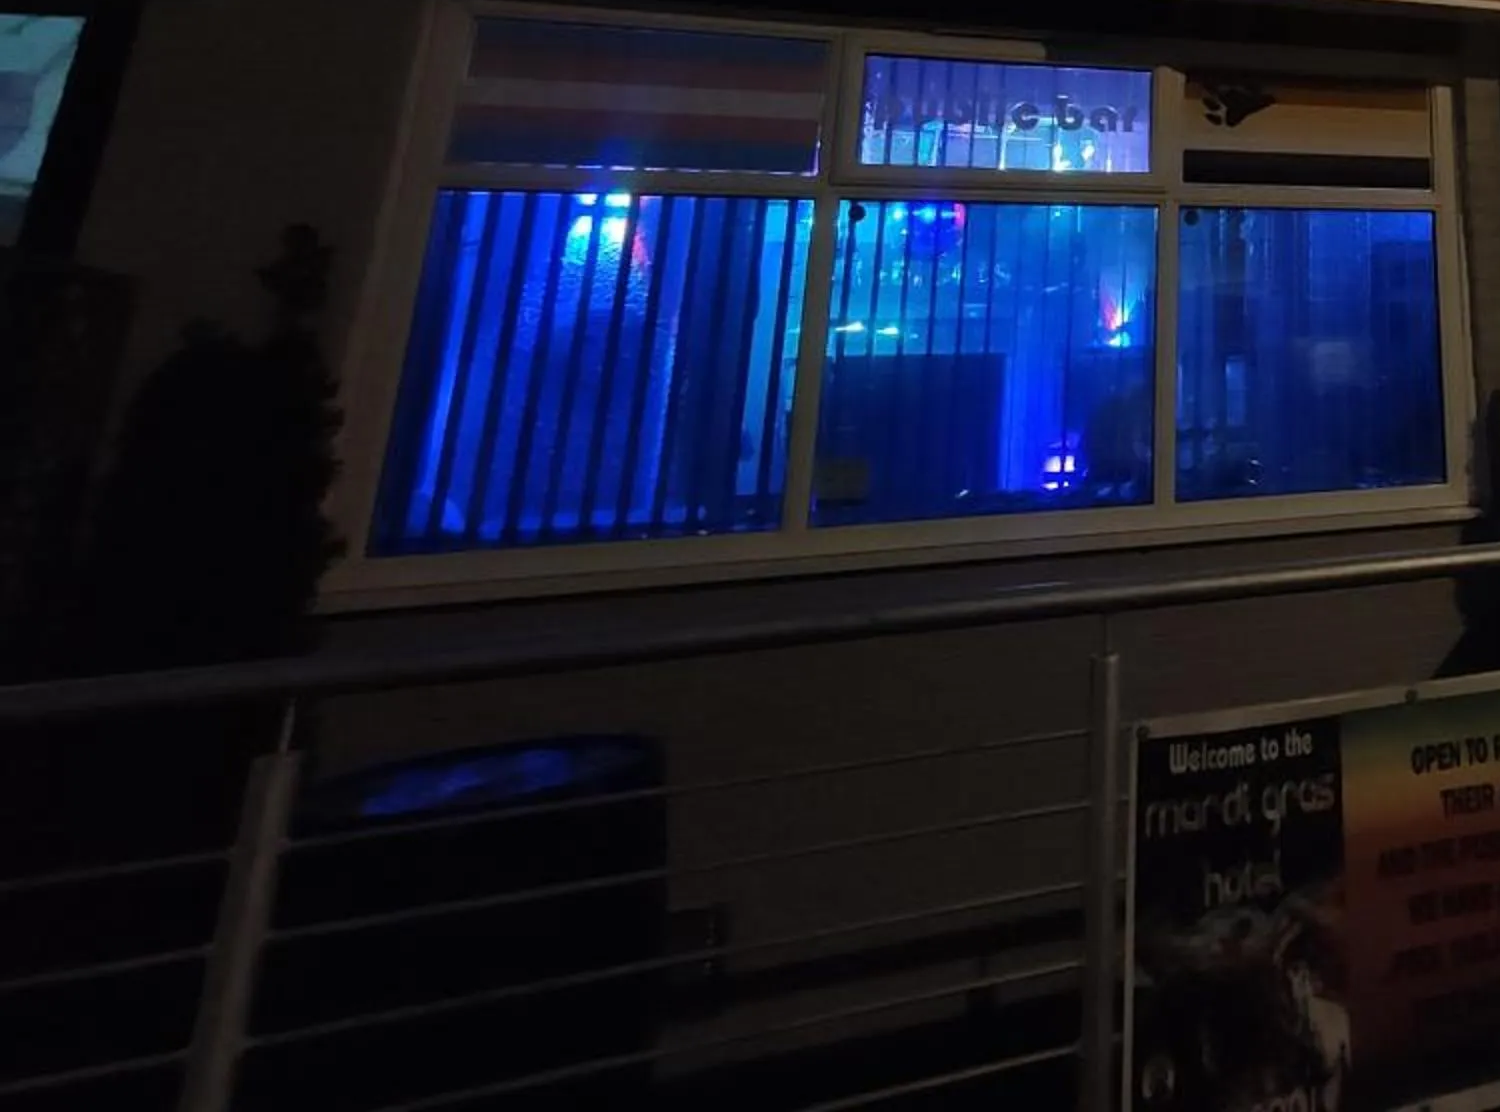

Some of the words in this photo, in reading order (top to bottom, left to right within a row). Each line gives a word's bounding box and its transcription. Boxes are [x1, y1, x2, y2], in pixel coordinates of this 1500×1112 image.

[1169, 741, 1257, 778] Welcome
[1260, 736, 1280, 762] to
[1284, 726, 1314, 759] the
[1411, 740, 1461, 775] OPEN
[1465, 736, 1489, 765] TO
[1144, 780, 1254, 839] mardi
[1261, 771, 1336, 837] gras
[1440, 783, 1494, 818] THEIR
